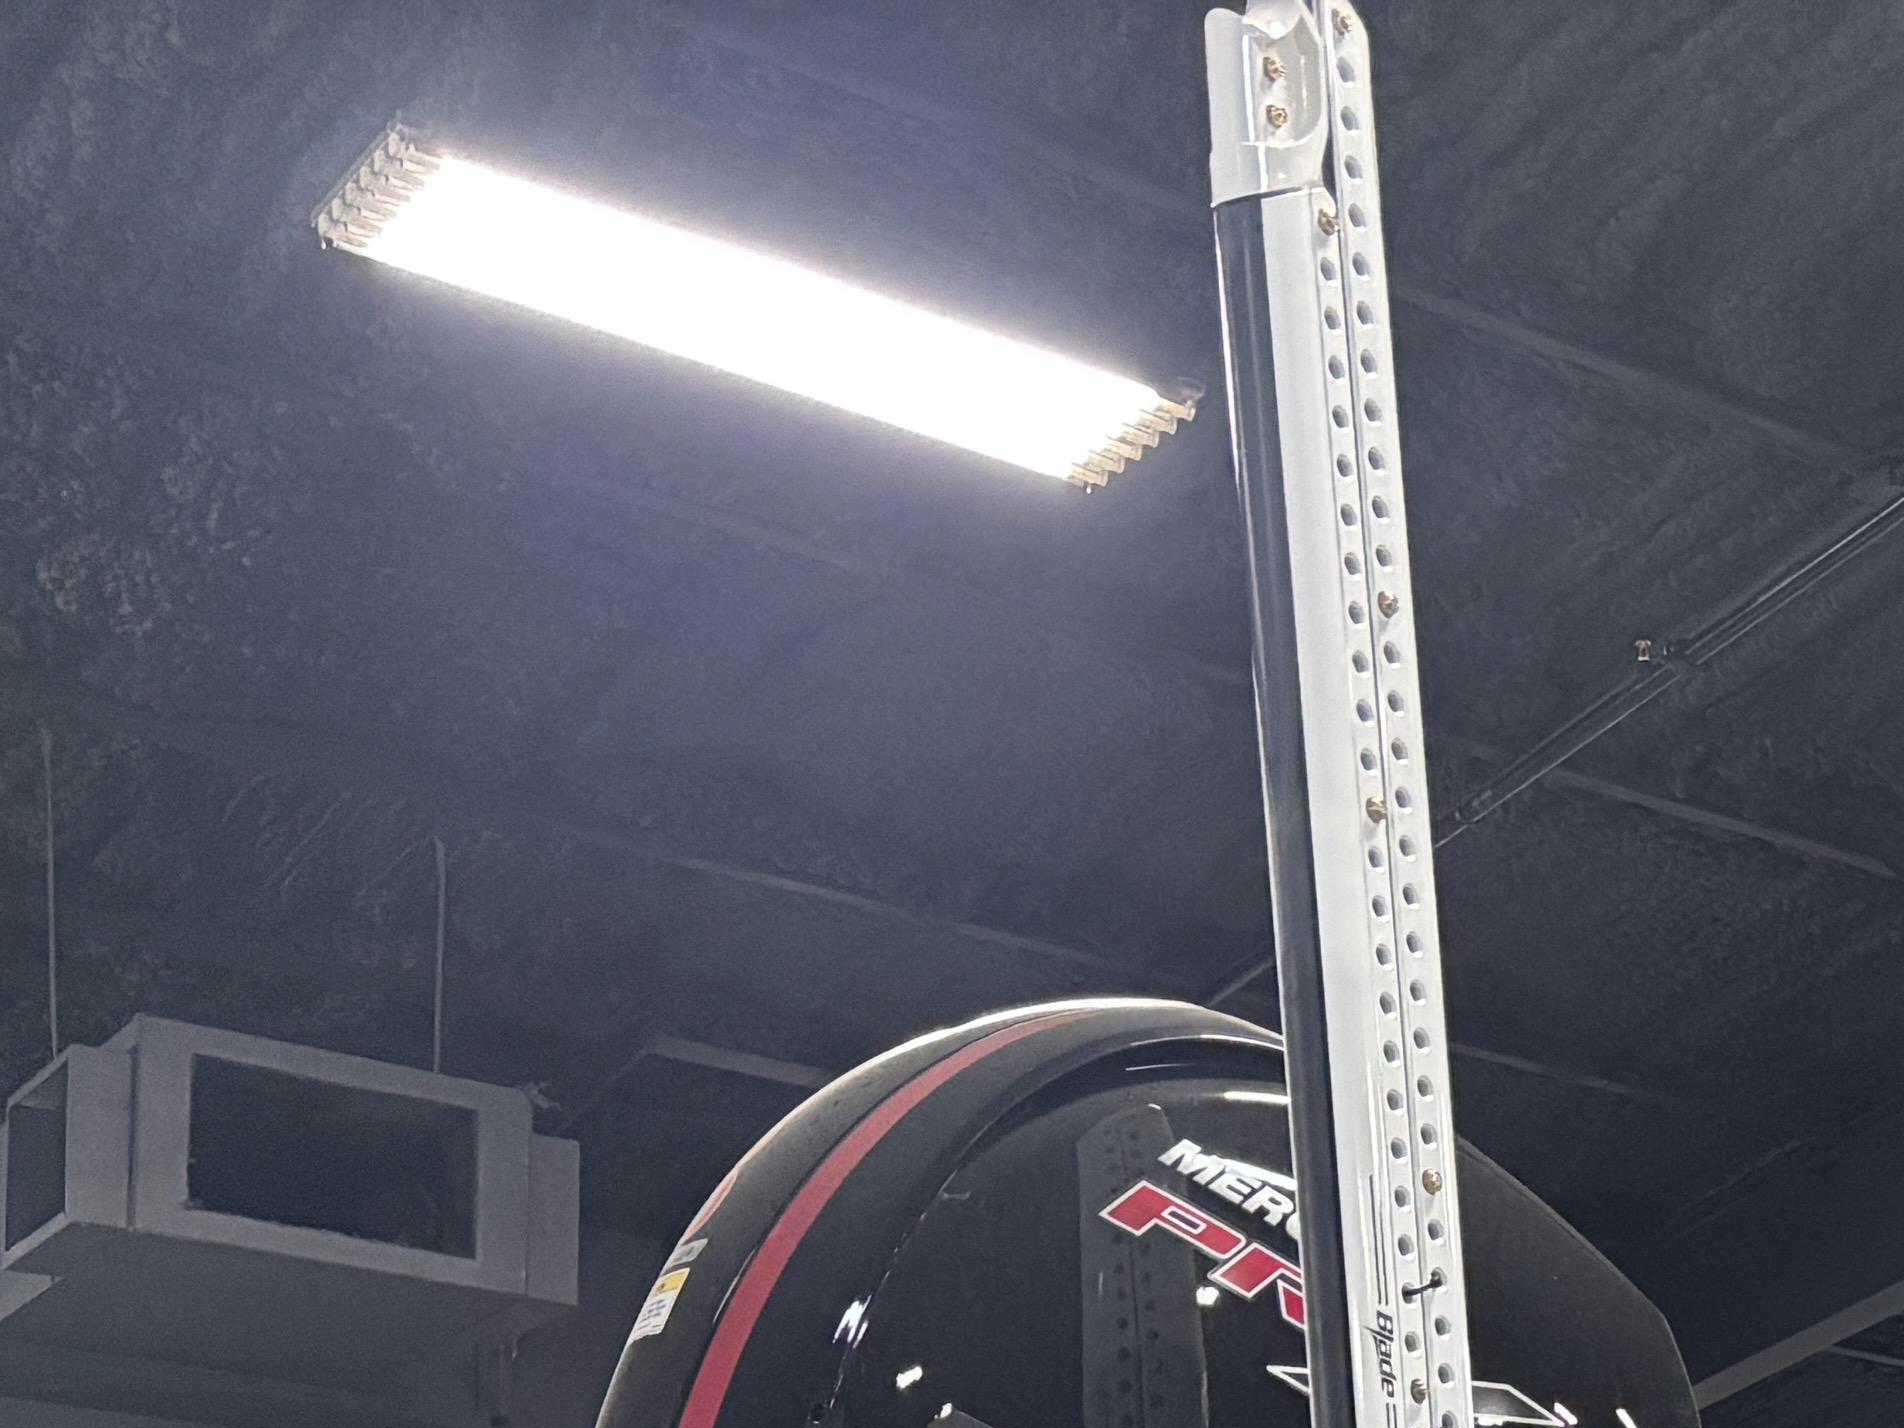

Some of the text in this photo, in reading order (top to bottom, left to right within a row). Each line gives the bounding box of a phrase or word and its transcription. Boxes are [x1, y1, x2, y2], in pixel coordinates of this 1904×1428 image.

[1157, 1138, 1299, 1243] MER
[1098, 1179, 1307, 1331] PR
[1363, 1310, 1397, 1398] Blade
